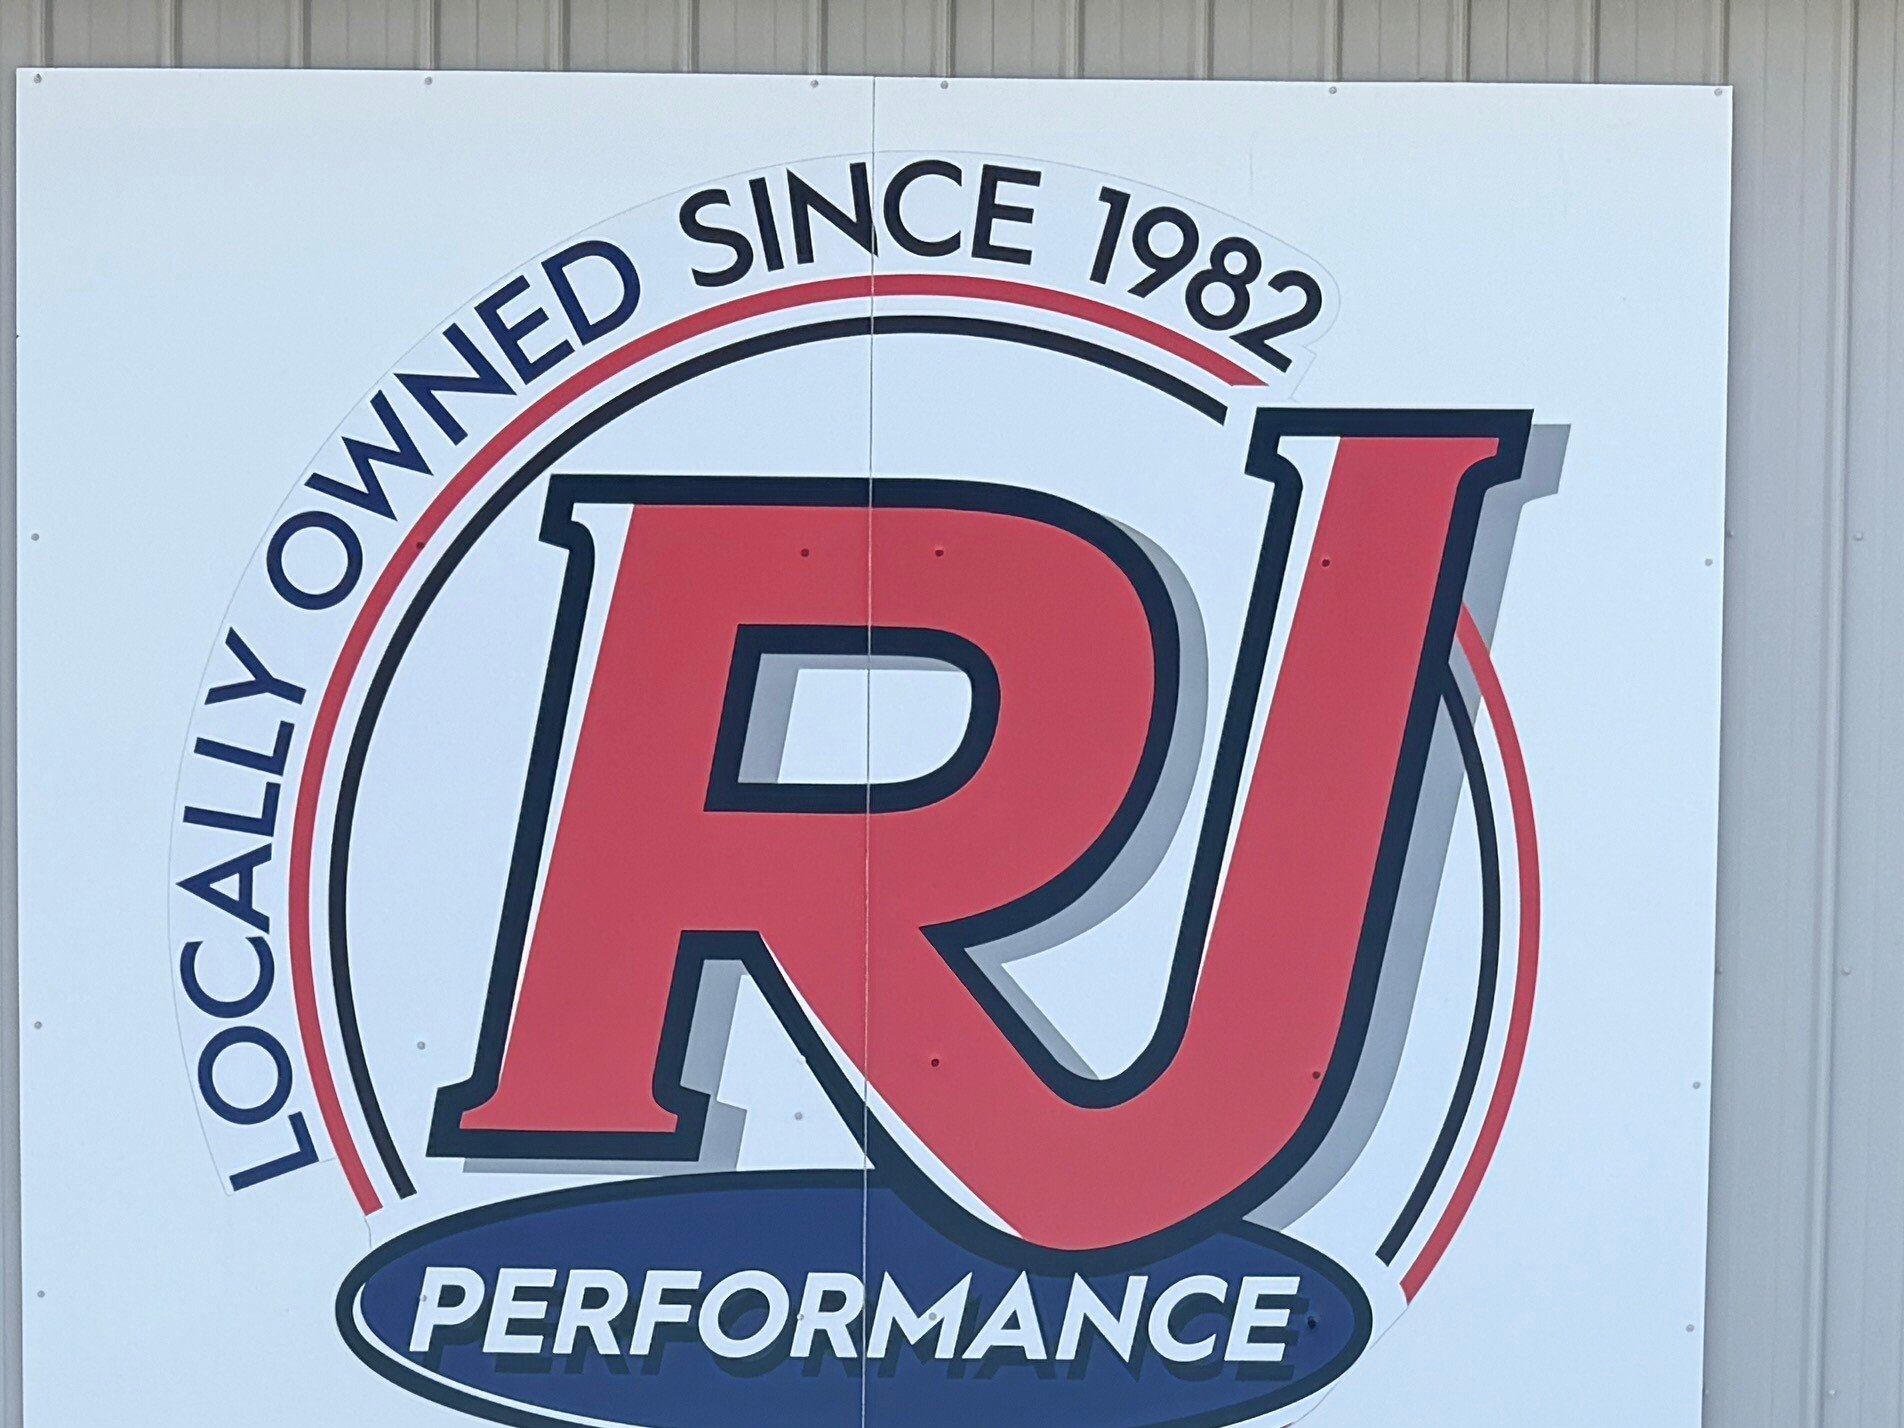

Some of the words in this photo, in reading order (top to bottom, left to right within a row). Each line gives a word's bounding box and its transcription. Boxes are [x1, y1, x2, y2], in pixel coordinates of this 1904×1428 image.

[176, 627, 319, 1191] LOCALLY
[267, 241, 640, 610] OWNED
[679, 160, 1041, 287] SINCE
[1090, 186, 1322, 372] 1982
[428, 408, 1533, 1267] RJ
[409, 1266, 1301, 1363] PERFORMANCE
